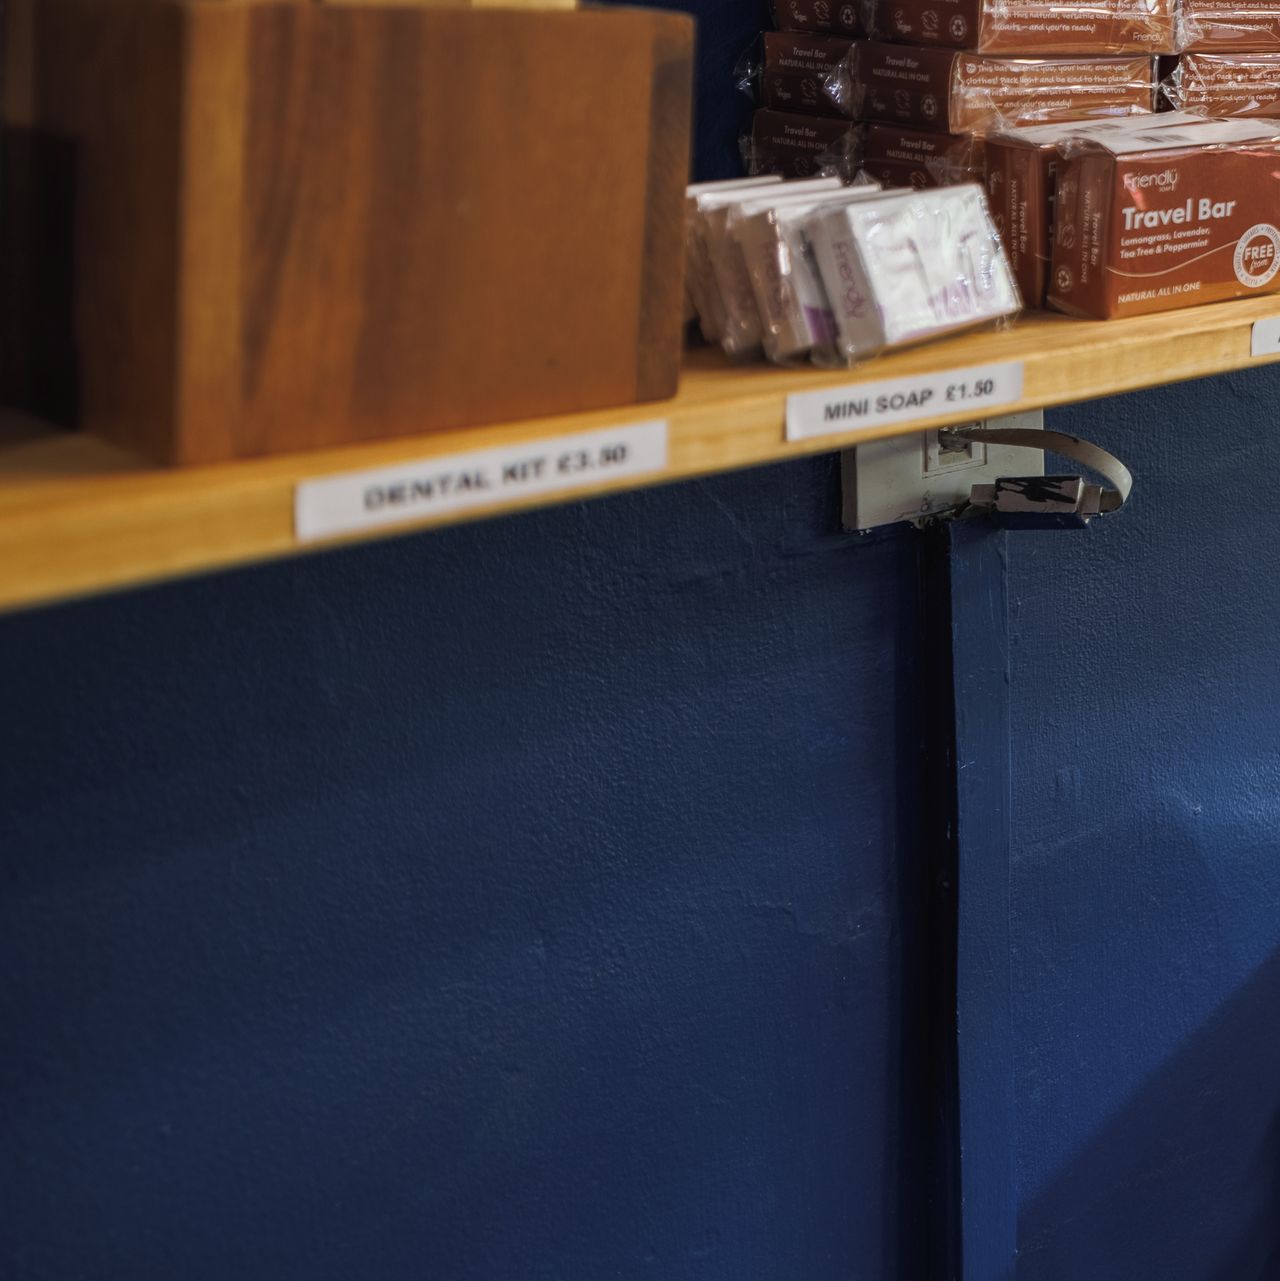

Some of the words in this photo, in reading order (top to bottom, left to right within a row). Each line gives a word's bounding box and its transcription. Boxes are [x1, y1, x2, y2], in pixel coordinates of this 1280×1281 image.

[1072, 24, 1096, 33] ready!
[966, 77, 998, 85] clothes!
[1020, 76, 1038, 85] light
[1122, 198, 1191, 230] Travel
[1199, 198, 1236, 220] Bar
[1121, 234, 1171, 247] Lemongrass,
[1174, 227, 1210, 239] Lavender,
[1120, 250, 1135, 259] Tea
[1137, 246, 1154, 256] Tree
[1156, 245, 1162, 253] &
[1164, 239, 1208, 254] Peppermint
[1244, 244, 1273, 261] FREE
[1249, 259, 1268, 273] from
[1118, 289, 1156, 303] NATURAL
[1158, 287, 1171, 296] ALL
[1173, 285, 1181, 294] IN
[1183, 281, 1200, 292] ONE
[824, 400, 868, 421] MINI
[875, 388, 933, 413] SOAP
[945, 379, 994, 401] £1.50
[364, 470, 487, 511] DENTAL
[501, 456, 546, 485] KIT
